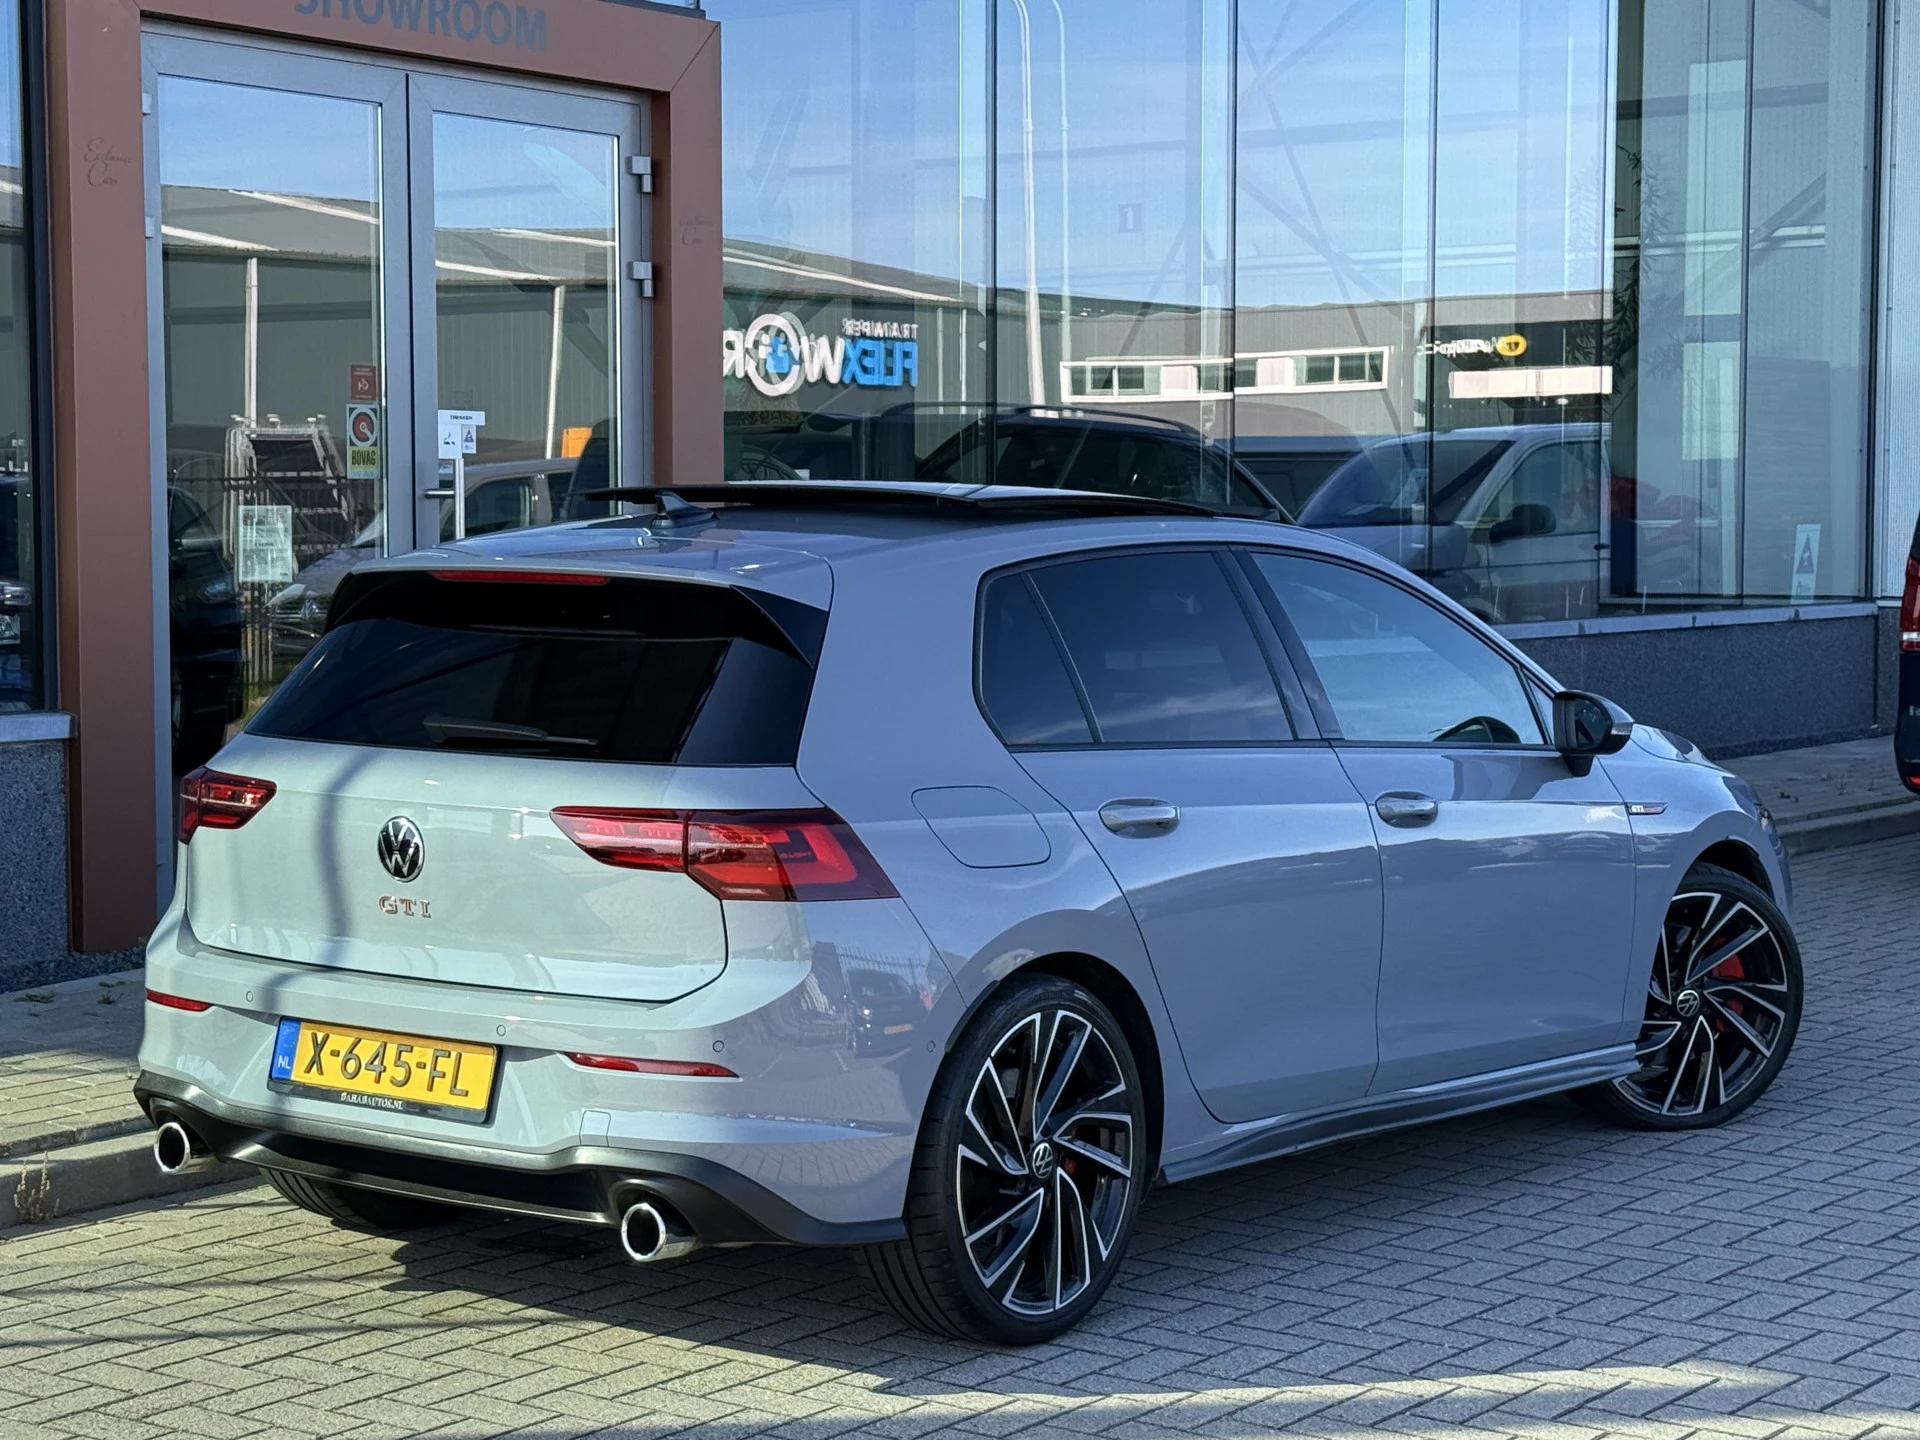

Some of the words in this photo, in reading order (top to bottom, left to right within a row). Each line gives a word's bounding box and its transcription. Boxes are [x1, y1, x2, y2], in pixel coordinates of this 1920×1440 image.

[351, 450, 376, 466] BOVAG
[379, 896, 431, 918] GTI
[277, 1055, 291, 1070] NL
[304, 1032, 469, 1097] X-645-FL
